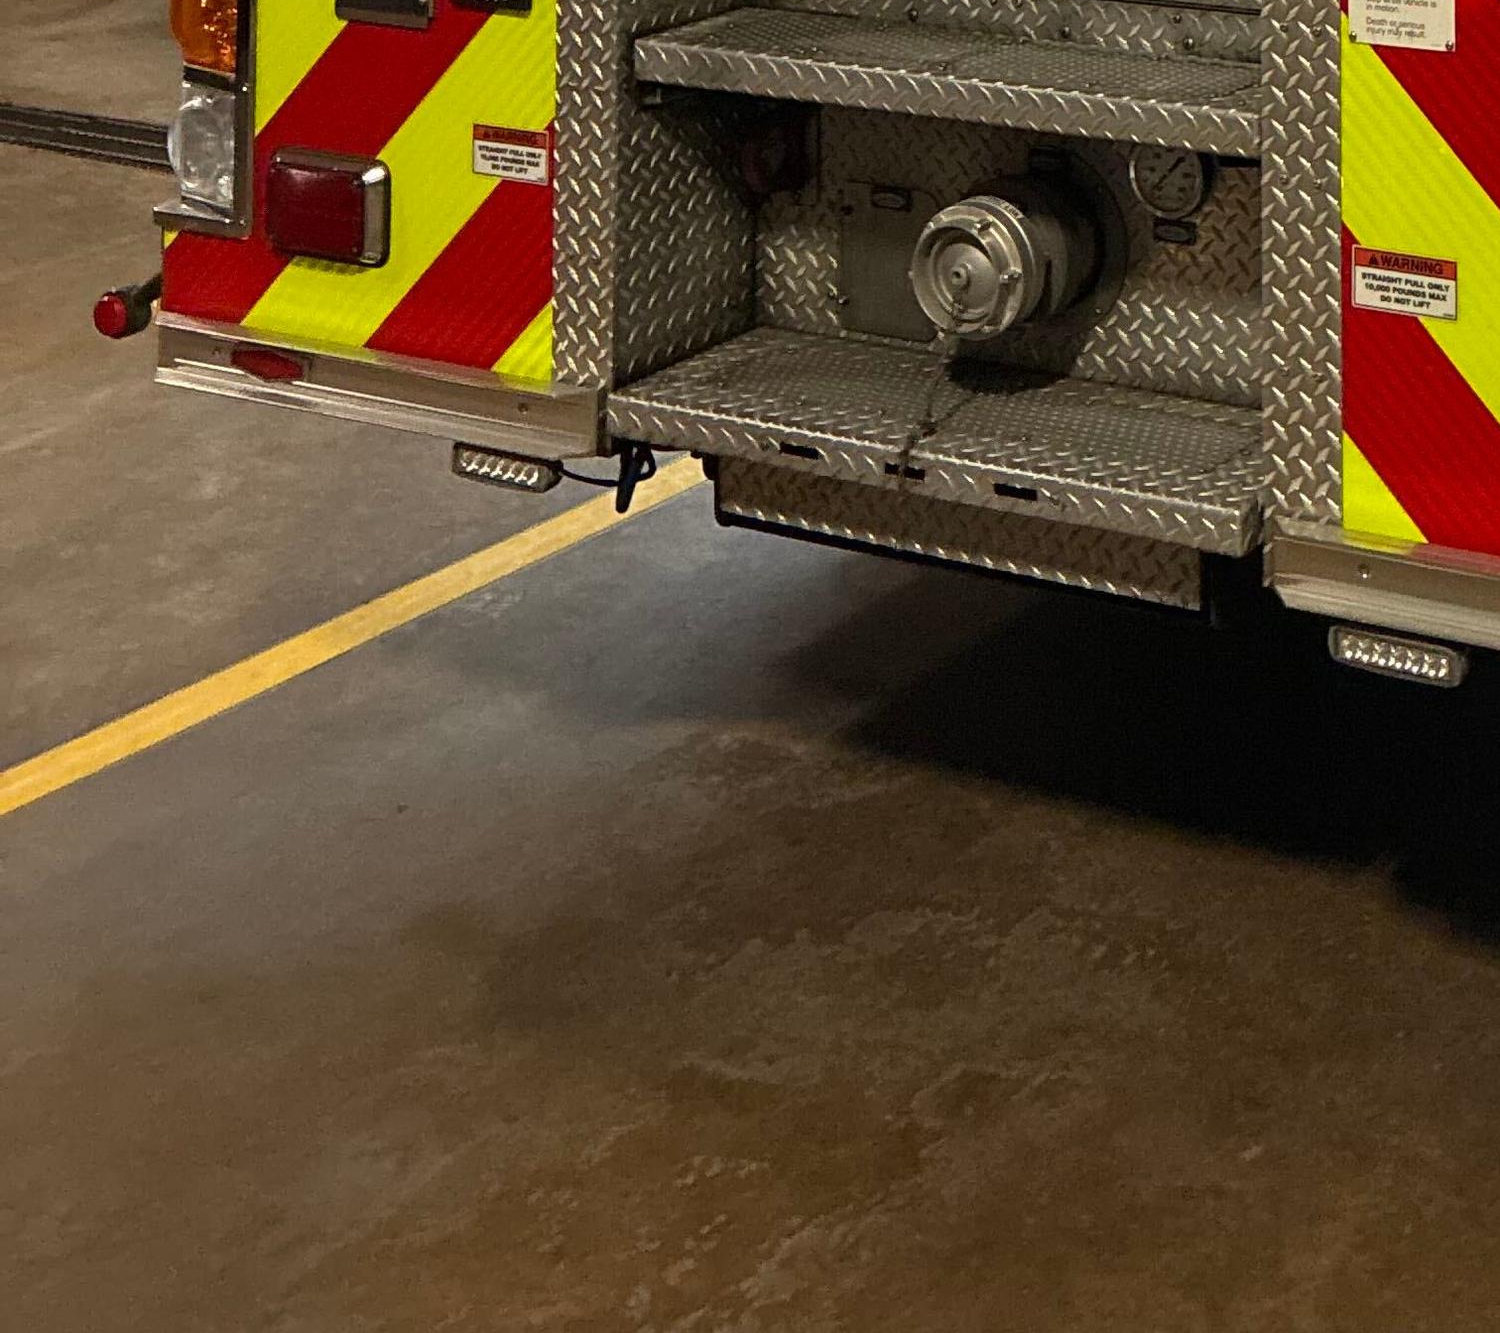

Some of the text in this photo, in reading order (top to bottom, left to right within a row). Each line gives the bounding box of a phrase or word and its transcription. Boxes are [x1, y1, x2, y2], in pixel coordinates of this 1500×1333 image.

[1381, 255, 1443, 275] WARNING
[1362, 272, 1450, 293] STRAIGHT PULL ONLY
[1380, 295, 1431, 310] DO NOT LIFT
[1393, 286, 1426, 299] POUNDS
[1429, 291, 1447, 302] MAX
